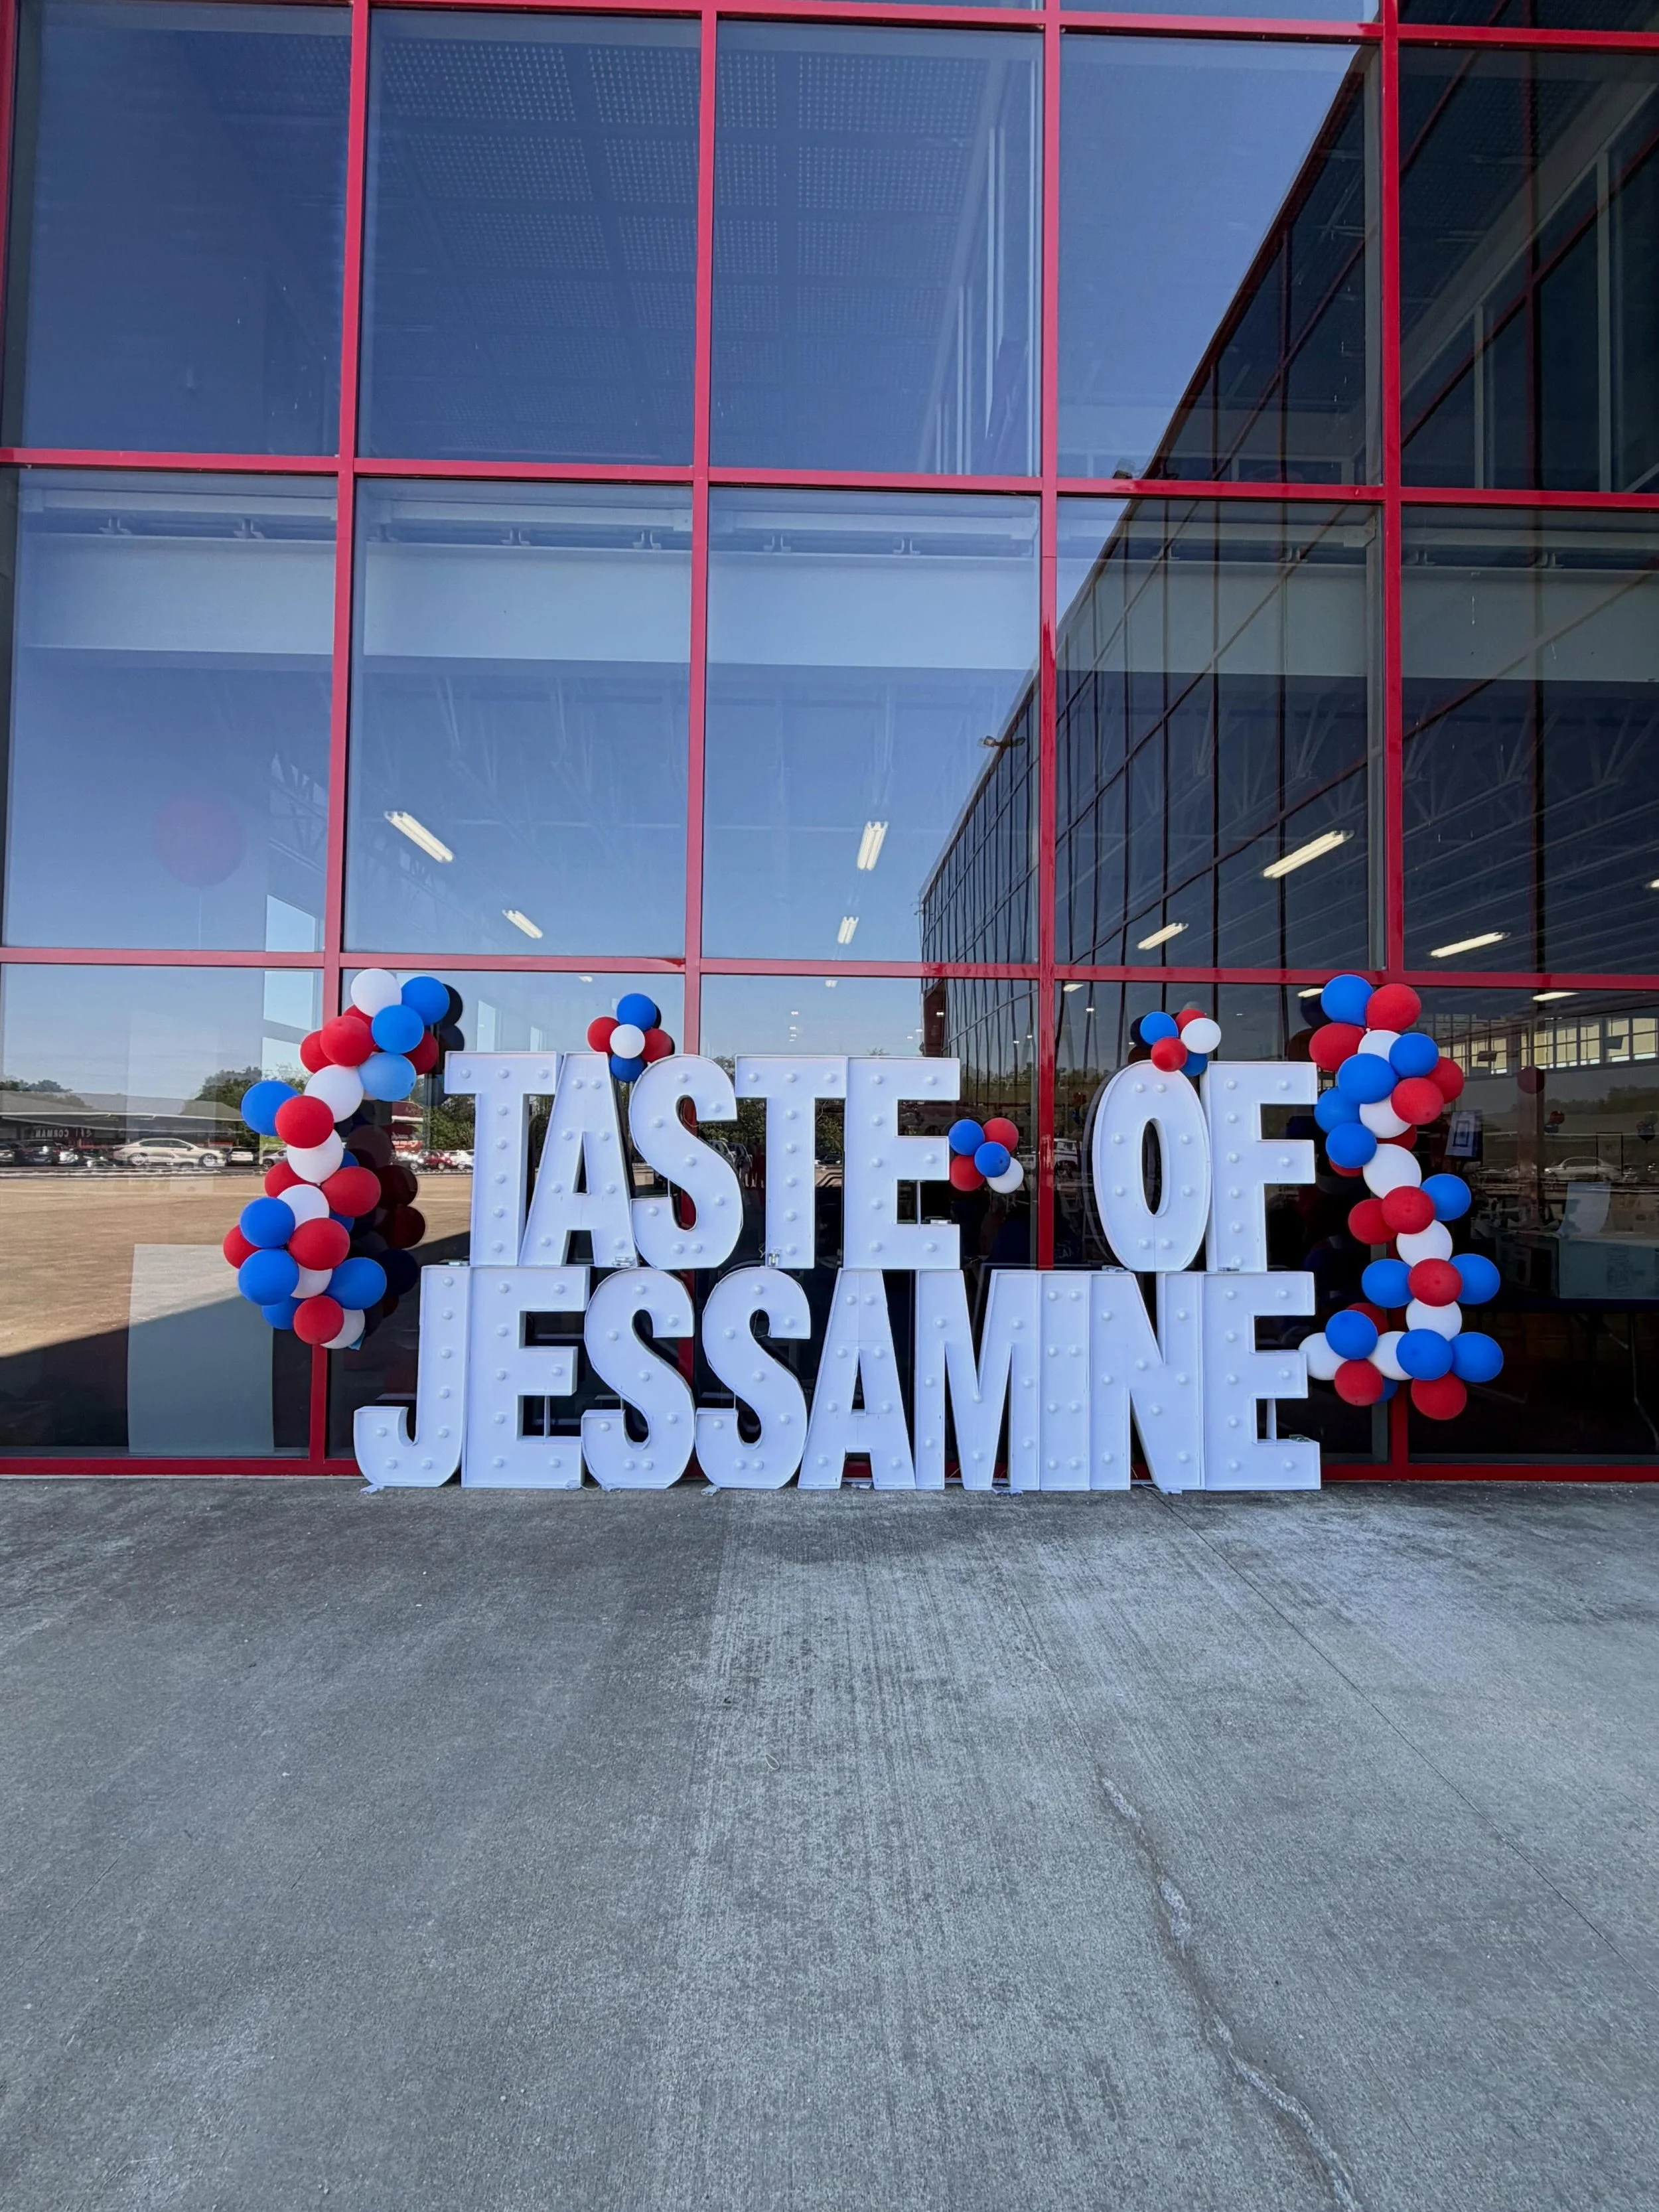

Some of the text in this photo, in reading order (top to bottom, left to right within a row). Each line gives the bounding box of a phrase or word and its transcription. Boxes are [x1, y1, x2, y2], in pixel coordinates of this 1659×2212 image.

[445, 1051, 1317, 1272] TASTE OF
[353, 1265, 1321, 1492] JESSAMINE
